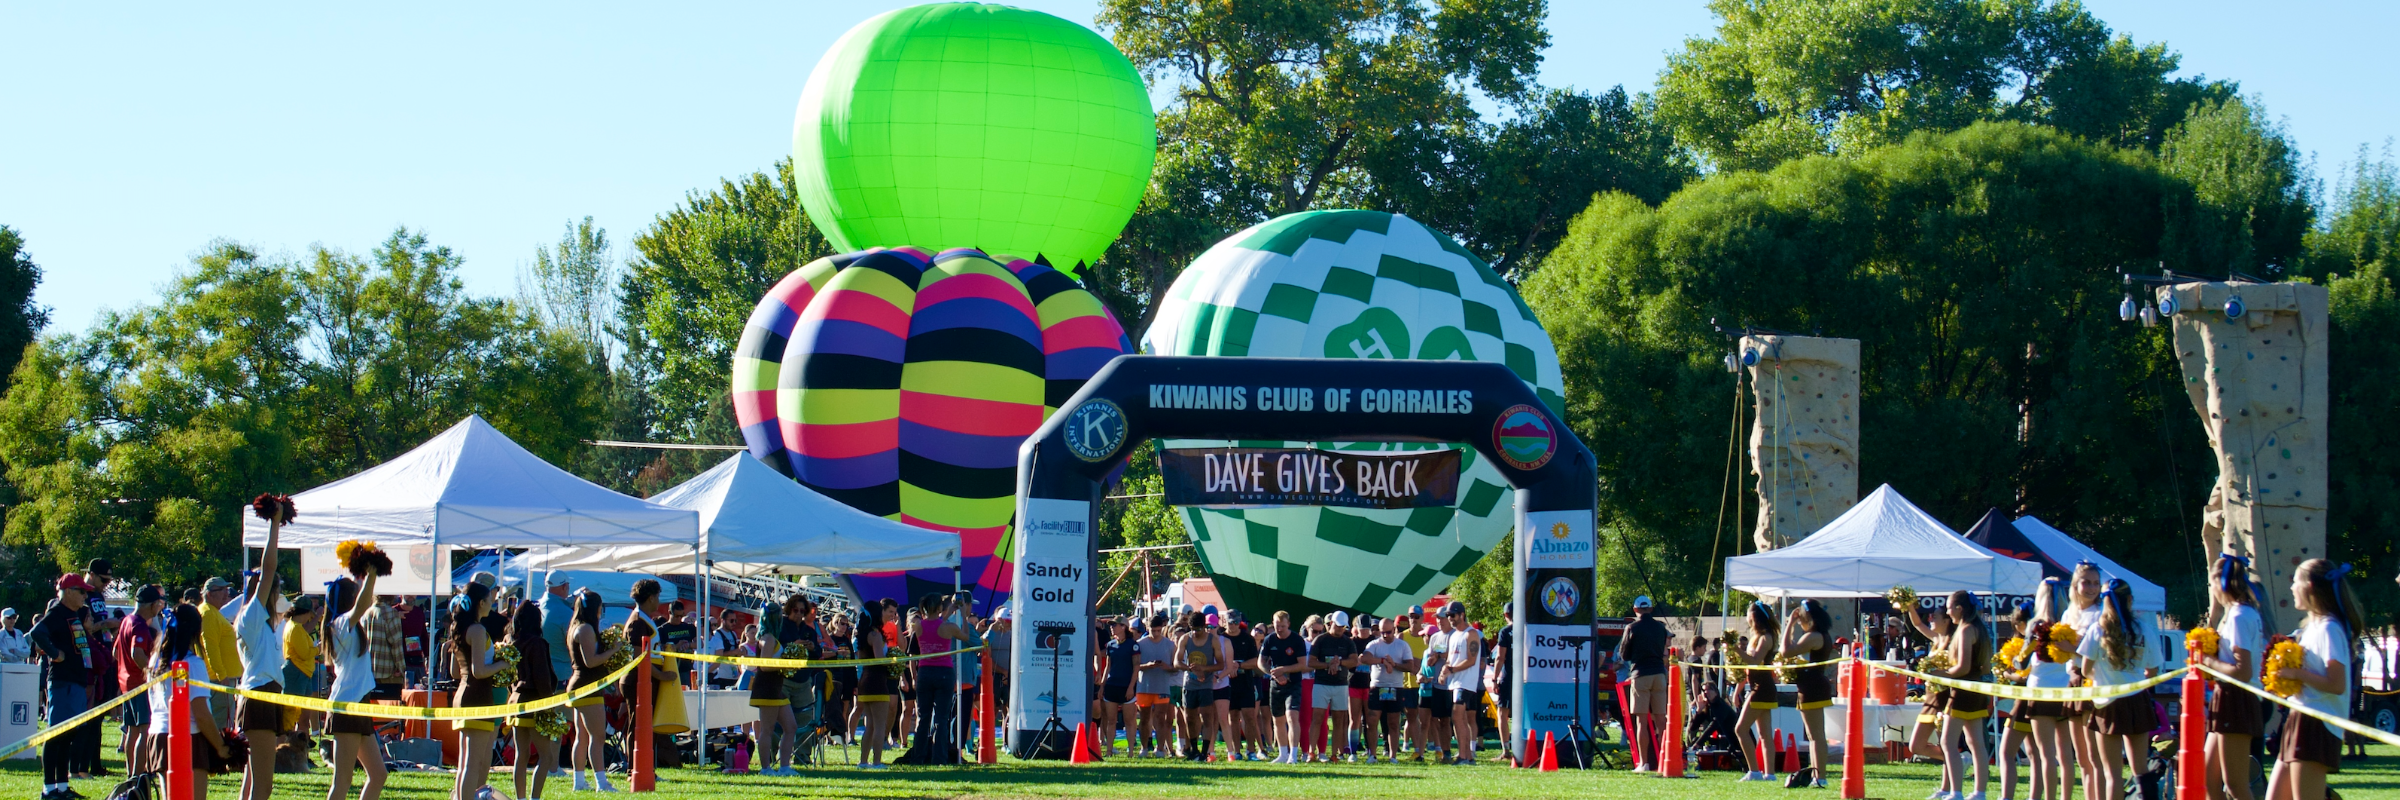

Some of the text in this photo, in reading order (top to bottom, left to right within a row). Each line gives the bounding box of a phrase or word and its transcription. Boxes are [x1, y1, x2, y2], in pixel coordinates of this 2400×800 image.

[1149, 384, 1473, 414] KIWANIS CLUB OF CORRALES
[1076, 403, 1118, 418] KIWANIS
[1504, 406, 1545, 420] KIWANIS CLUB
[1083, 411, 1110, 449] K
[1068, 424, 1123, 457] INTERNATIONAL
[1541, 451, 1552, 462] USA
[1204, 453, 1420, 498] DAVE GIVES BACK
[1530, 538, 1589, 554] Abrazo
[1539, 553, 1583, 561] HOMES
[1026, 561, 1082, 582] Sandy
[1031, 587, 1074, 603] Gold
[1032, 620, 1075, 629] CORDOVA
[1547, 701, 1568, 710] Ann
